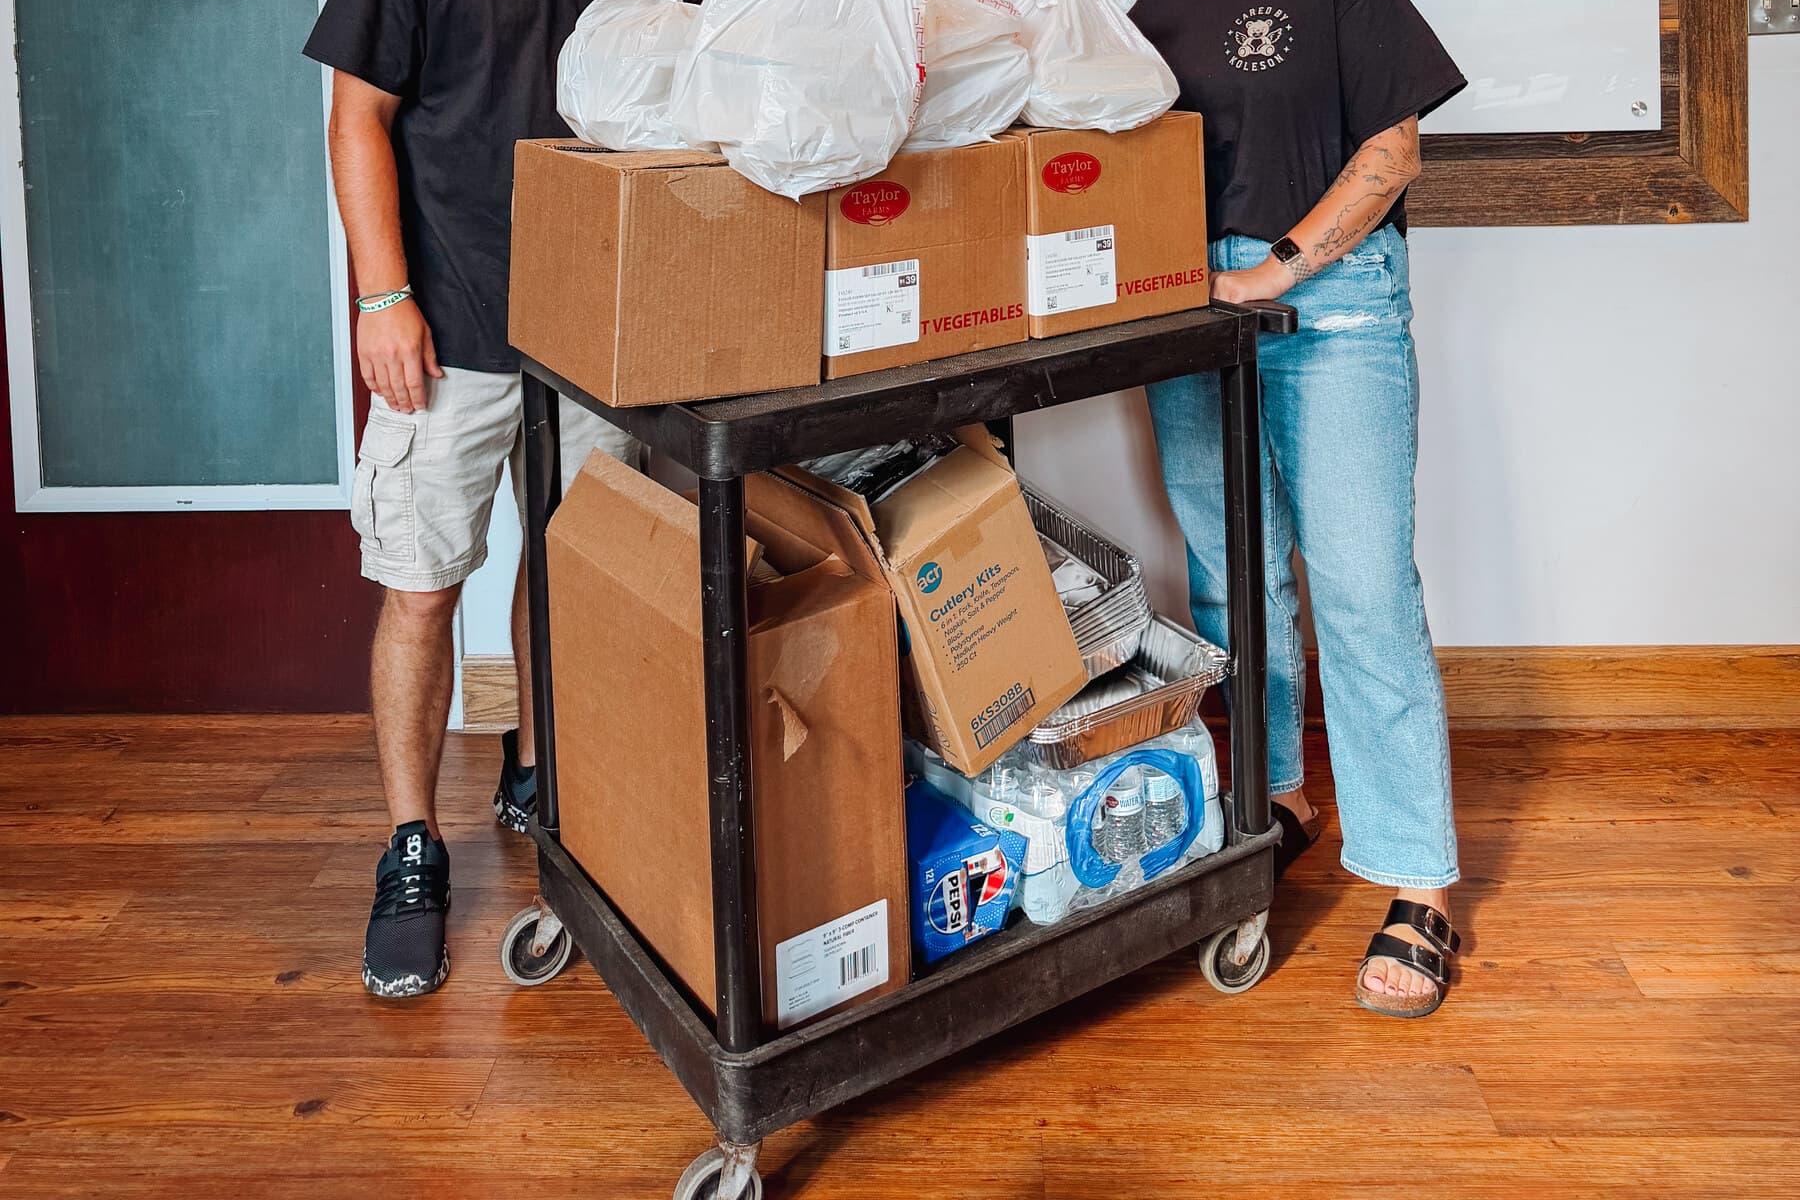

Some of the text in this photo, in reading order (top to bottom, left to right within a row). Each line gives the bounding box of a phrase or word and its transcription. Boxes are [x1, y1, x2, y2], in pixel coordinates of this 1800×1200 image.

[1235, 6, 1289, 25] CARED BY
[1229, 54, 1284, 71] KOLESON
[1050, 159, 1093, 175] Taylor
[851, 188, 900, 206] Taylor
[1125, 268, 1205, 296] VEGETABLES
[933, 303, 1024, 335] VEGETABLES
[930, 564, 1001, 622] Cutlery Kits
[948, 874, 961, 929] PEPSI
